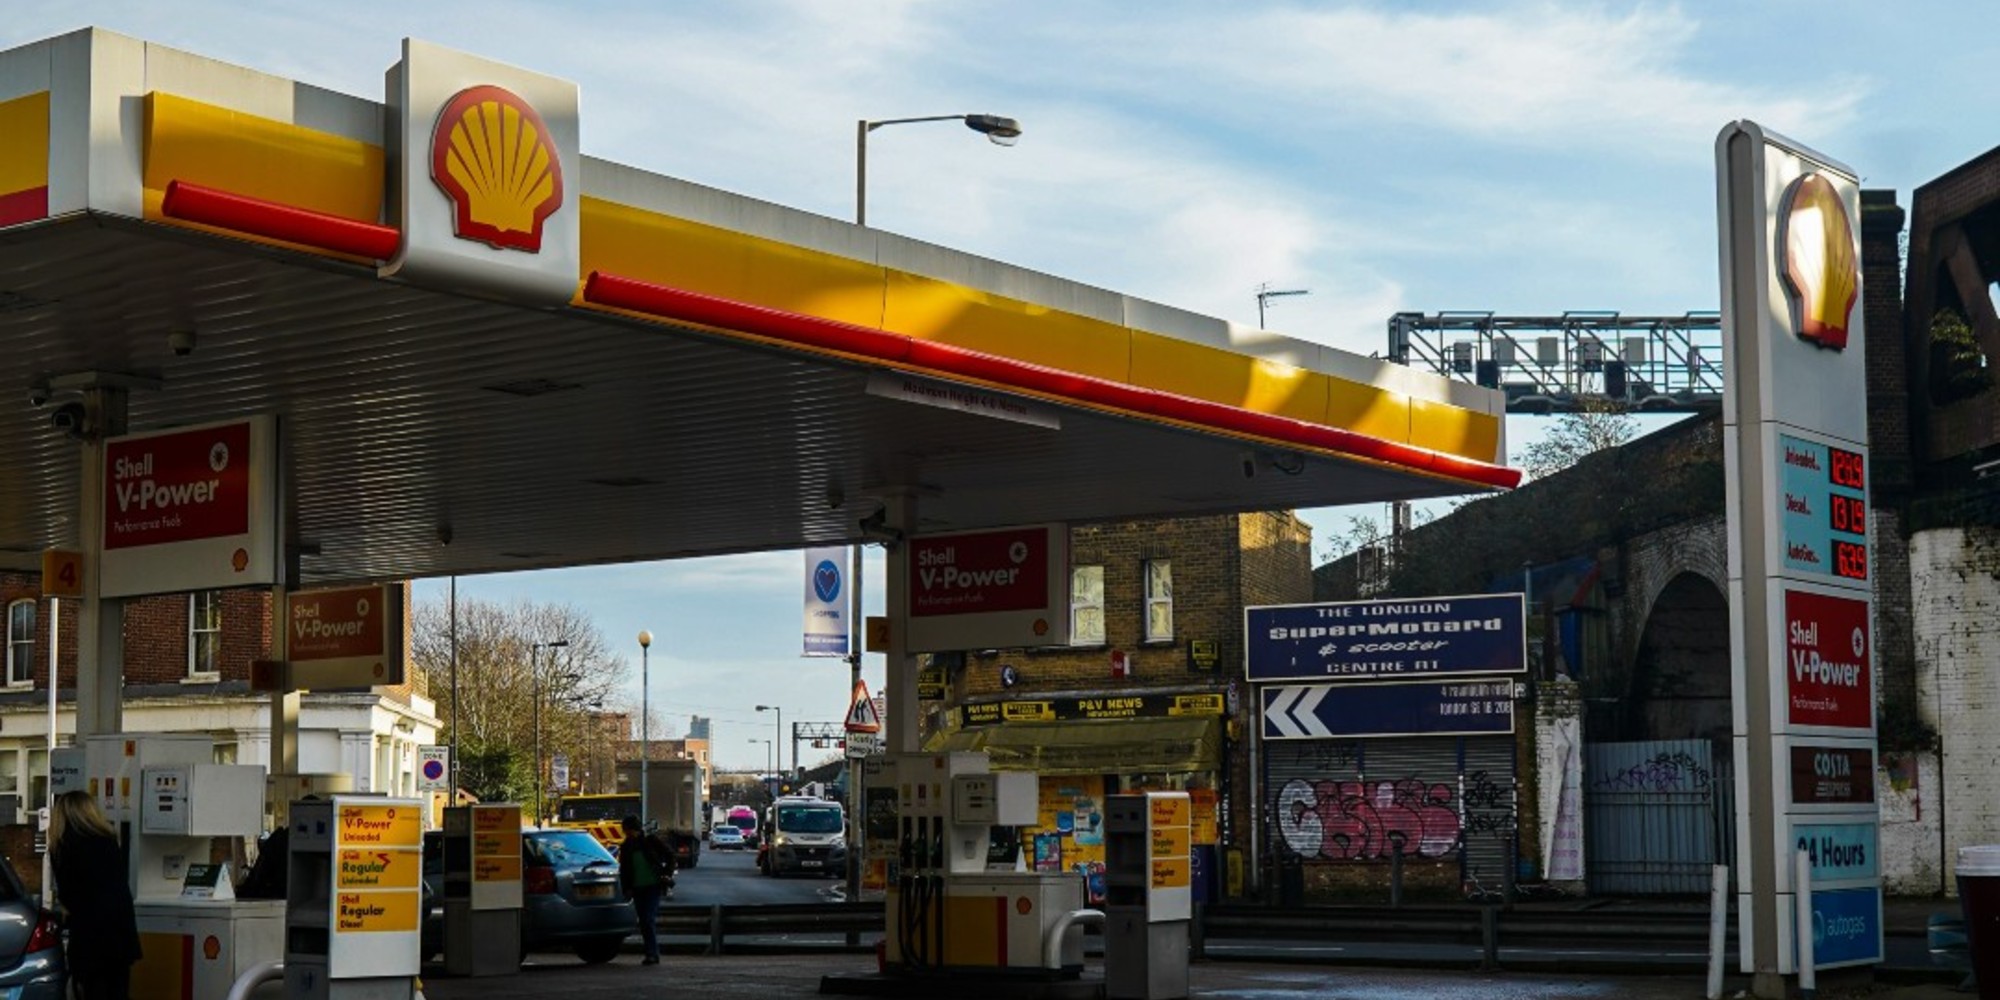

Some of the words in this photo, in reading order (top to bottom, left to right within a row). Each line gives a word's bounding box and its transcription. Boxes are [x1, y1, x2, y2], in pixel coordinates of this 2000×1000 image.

[114, 452, 153, 480] Shell
[115, 478, 220, 512] V-Power
[918, 546, 956, 566] Shell
[59, 562, 76, 588] 4
[920, 566, 1019, 591] V-Power
[294, 603, 320, 618] Shell
[1317, 607, 1353, 618] THE
[1362, 603, 1450, 616] LONDON
[295, 619, 364, 639] V-Power
[1790, 620, 1818, 646] Shell
[1347, 640, 1449, 654] scooter
[1326, 661, 1405, 674] CENTRE
[1414, 660, 1440, 670] AT
[1792, 648, 1861, 688] V-Power
[1078, 699, 1103, 711] P&V
[1106, 697, 1144, 709] NEWS
[1814, 753, 1851, 779] COSTA
[345, 818, 392, 830] V-Power
[1822, 836, 1865, 867] Hours
[342, 862, 385, 875] Regular
[341, 904, 385, 918] Regular
[340, 920, 364, 928] Diesel
[1826, 916, 1866, 940] autogas
